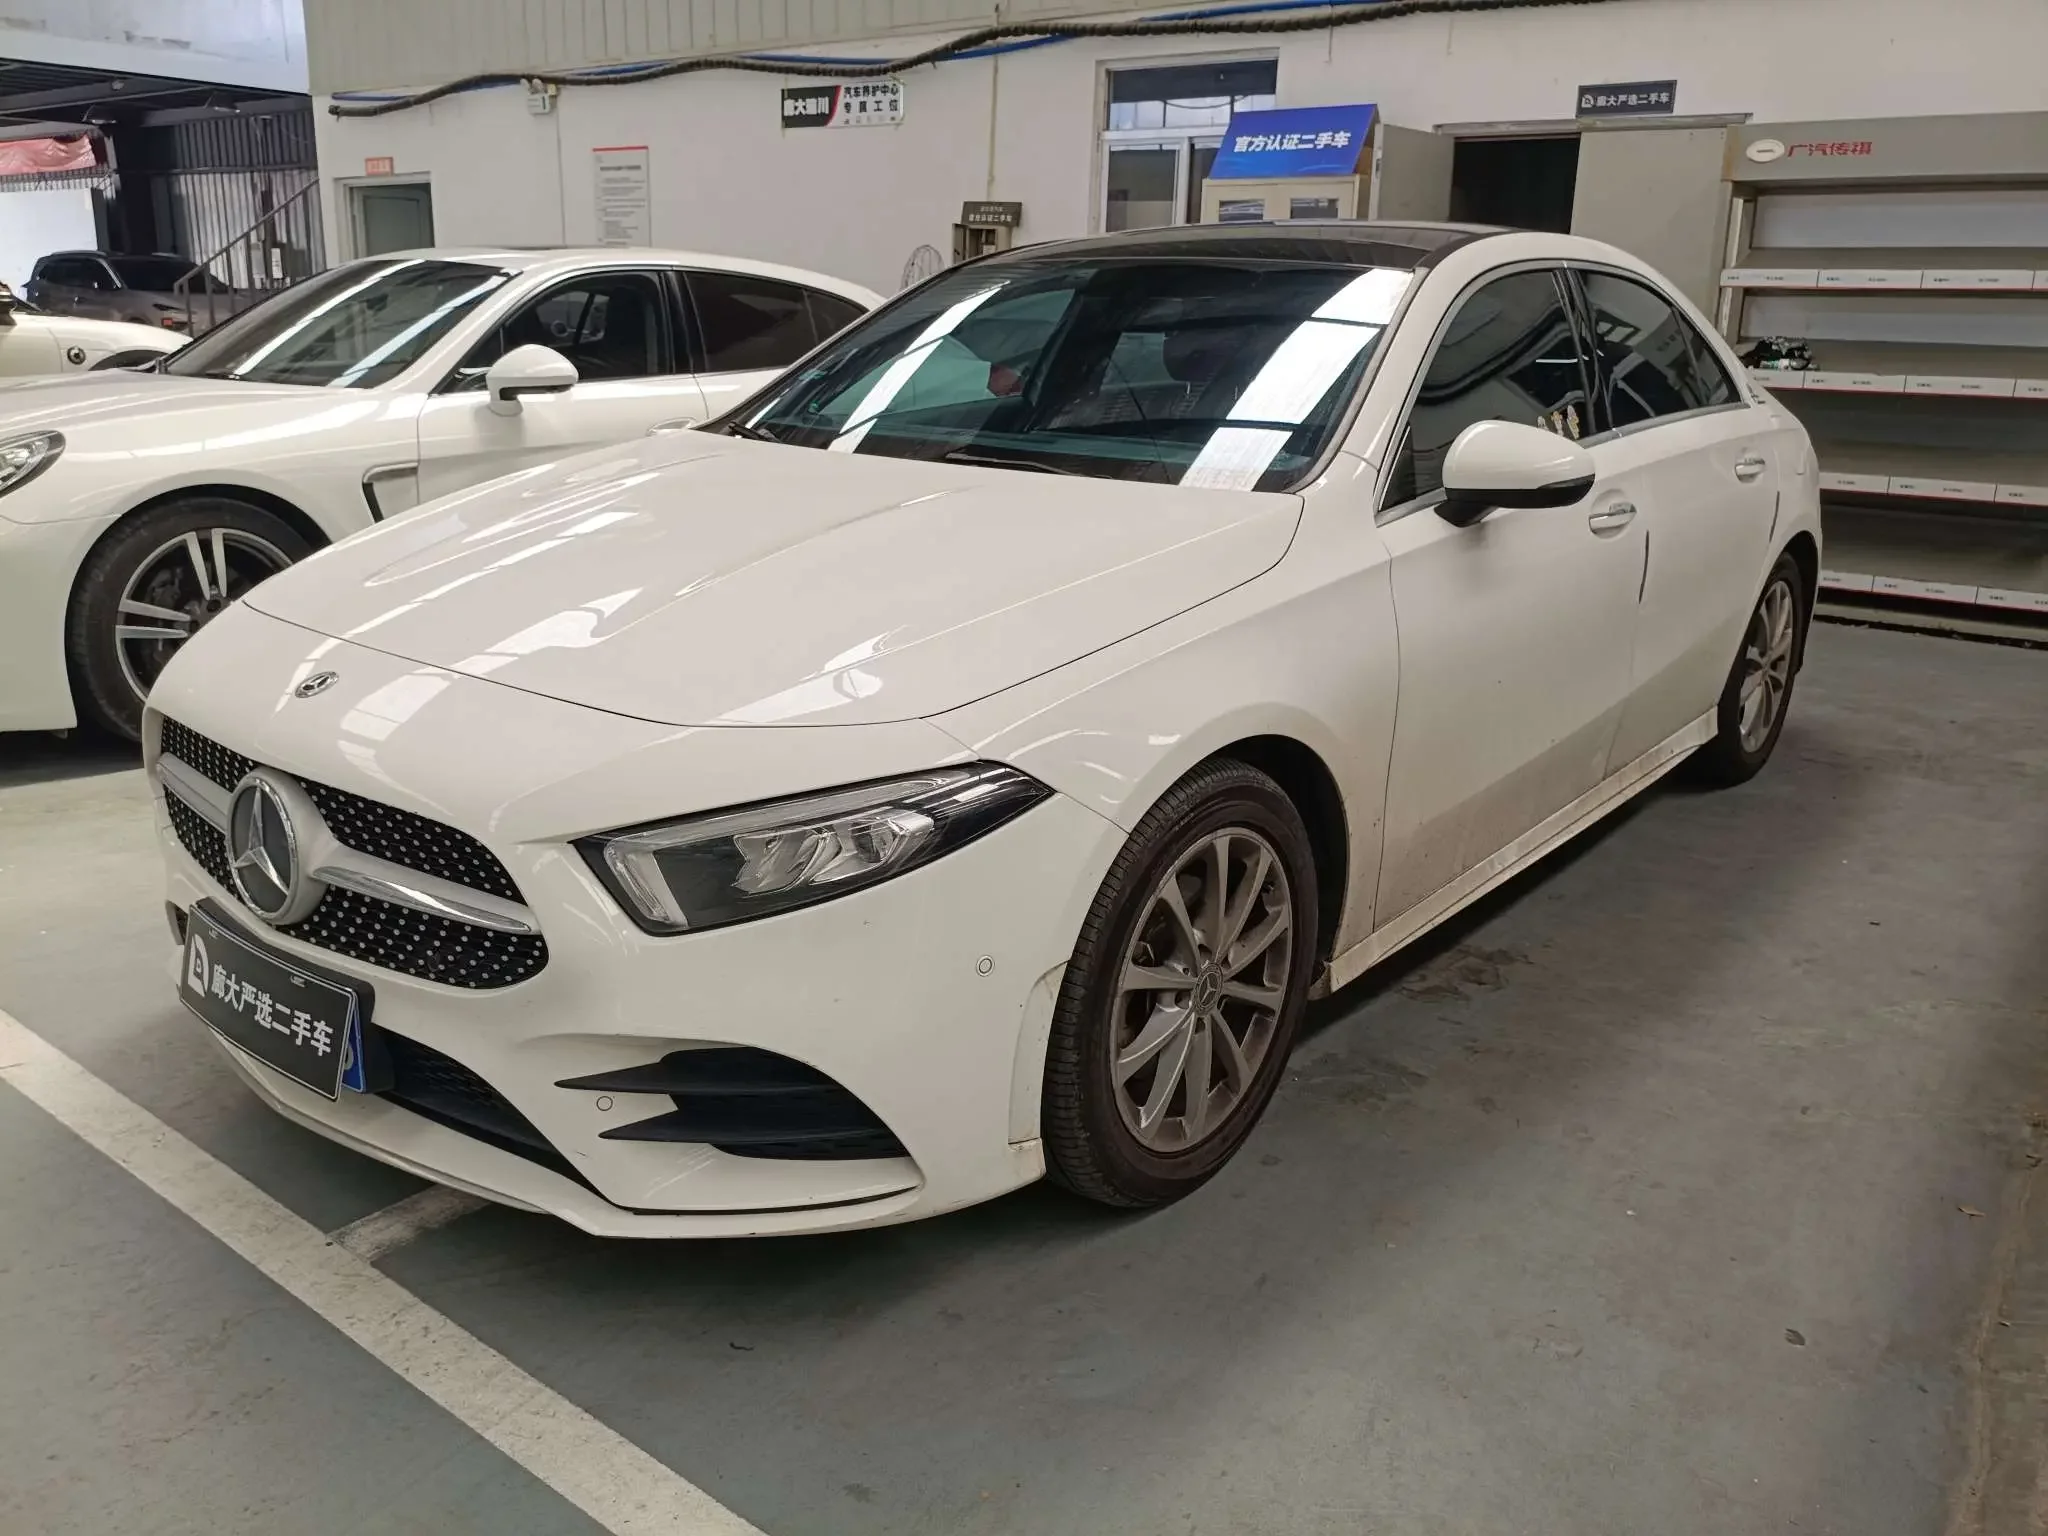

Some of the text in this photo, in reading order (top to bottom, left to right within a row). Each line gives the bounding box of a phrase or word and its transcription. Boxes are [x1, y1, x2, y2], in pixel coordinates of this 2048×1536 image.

[1233, 130, 1352, 153] 官方认证二手车
